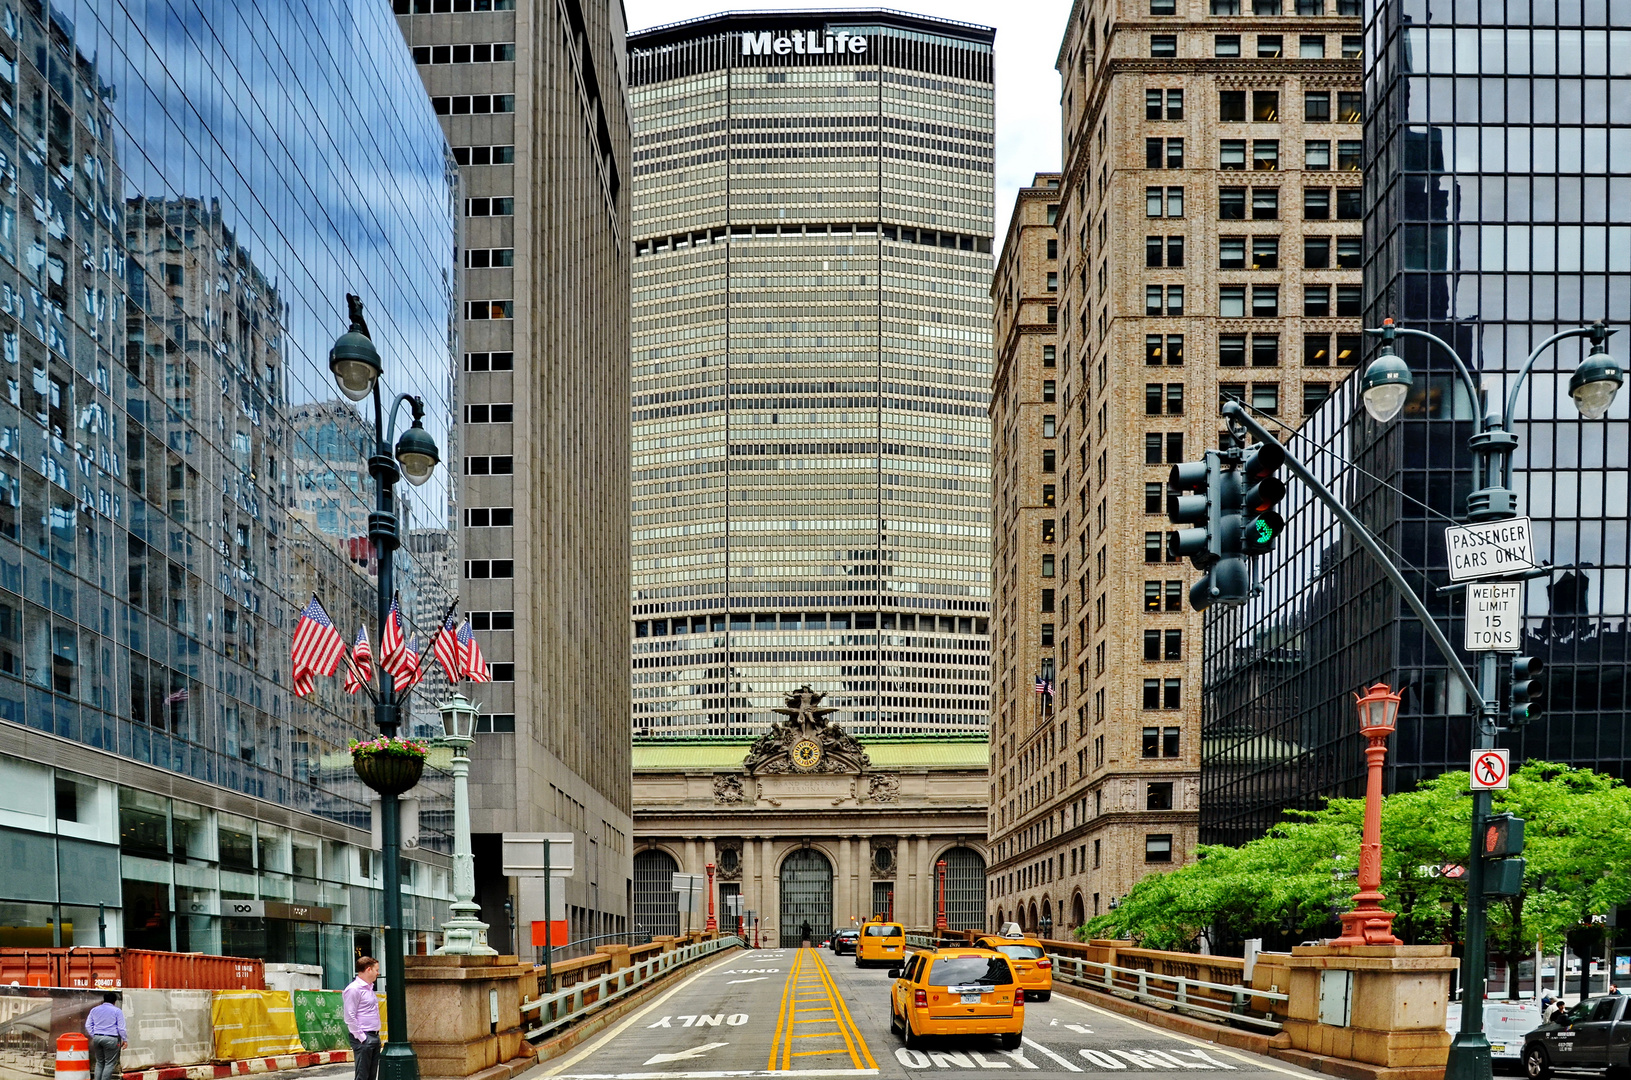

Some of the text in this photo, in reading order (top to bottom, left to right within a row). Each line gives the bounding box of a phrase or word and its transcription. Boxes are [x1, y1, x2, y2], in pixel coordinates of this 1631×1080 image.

[742, 30, 867, 56] MetLife
[1453, 525, 1525, 549] PASSENGER
[1455, 546, 1527, 569] CARS ONLY
[1472, 587, 1517, 599] WEIGHT
[1478, 601, 1508, 612] LIMIT
[1485, 615, 1502, 628] 15
[1474, 631, 1513, 644] TONS
[233, 904, 252, 913] 100
[646, 1013, 750, 1029] ONLY
[894, 1047, 1040, 1070] ONLY
[1078, 1048, 1238, 1070] ONLY
